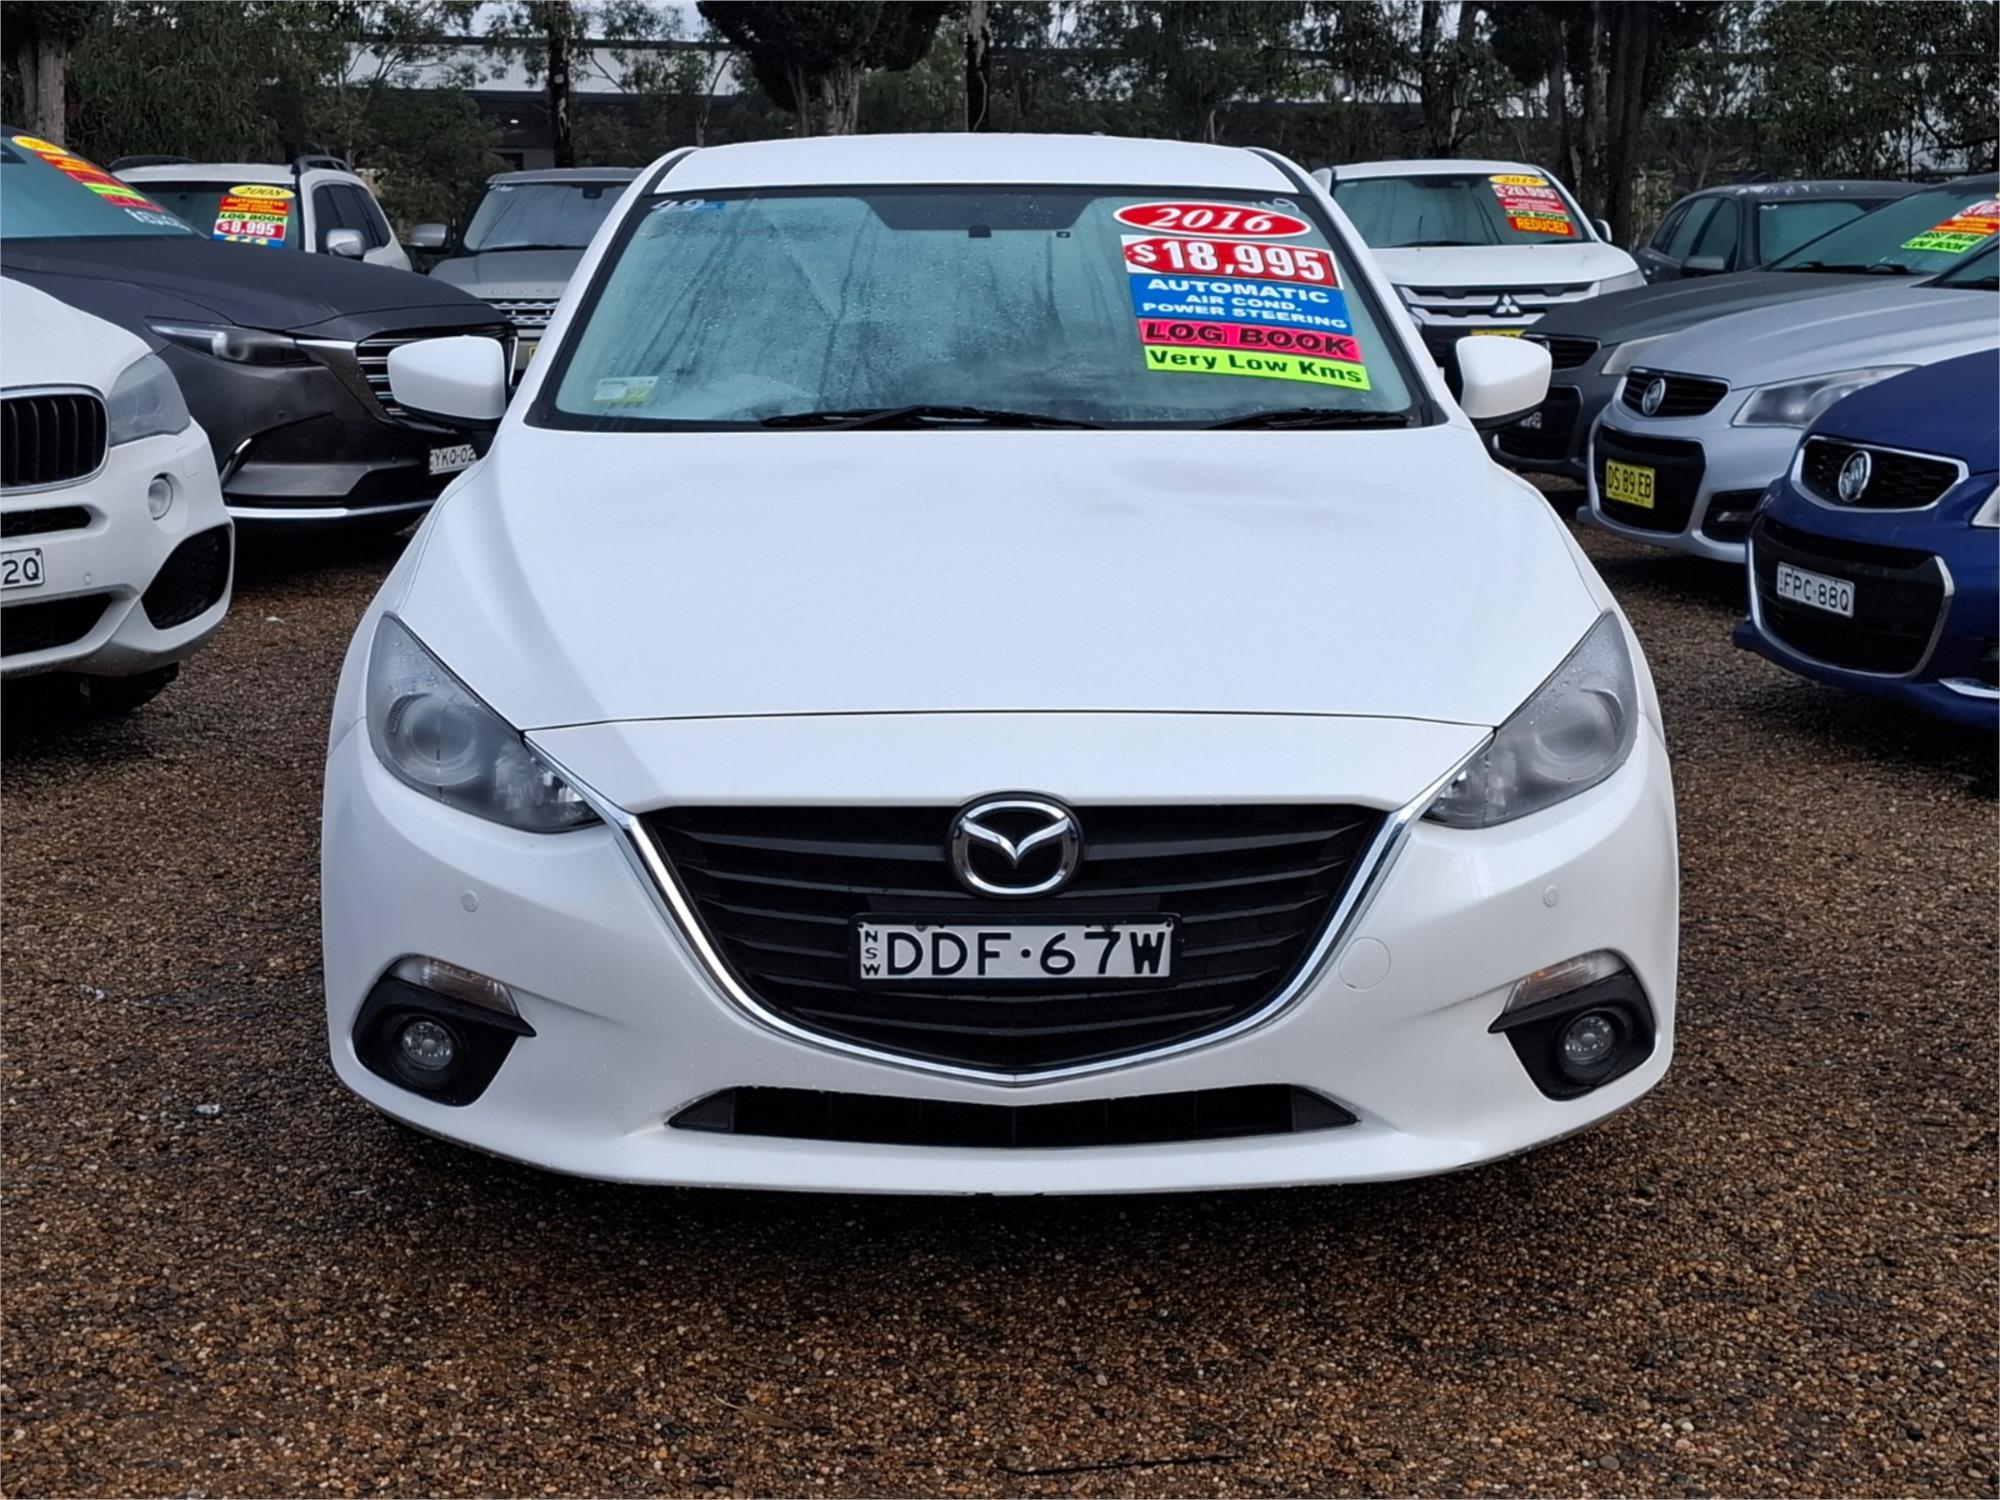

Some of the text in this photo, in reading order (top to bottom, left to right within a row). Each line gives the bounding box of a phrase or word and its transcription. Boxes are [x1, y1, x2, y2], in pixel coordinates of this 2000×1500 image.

[220, 221, 276, 236] $8,995
[248, 214, 286, 223] BOOK
[1148, 207, 1276, 232] 2016
[1515, 217, 1569, 234] REDUCED
[1133, 240, 1326, 282] $18,995
[1147, 278, 1331, 304] AUTOMATIC
[1186, 294, 1303, 312] AIR COND.
[1142, 302, 1348, 330] POWER STEERING
[1145, 322, 1356, 356] LOG BOOK
[1149, 349, 1363, 384] Very Low Kms
[1623, 469, 1635, 495] 89
[2, 556, 40, 586] 2Q
[863, 930, 881, 976] NSW
